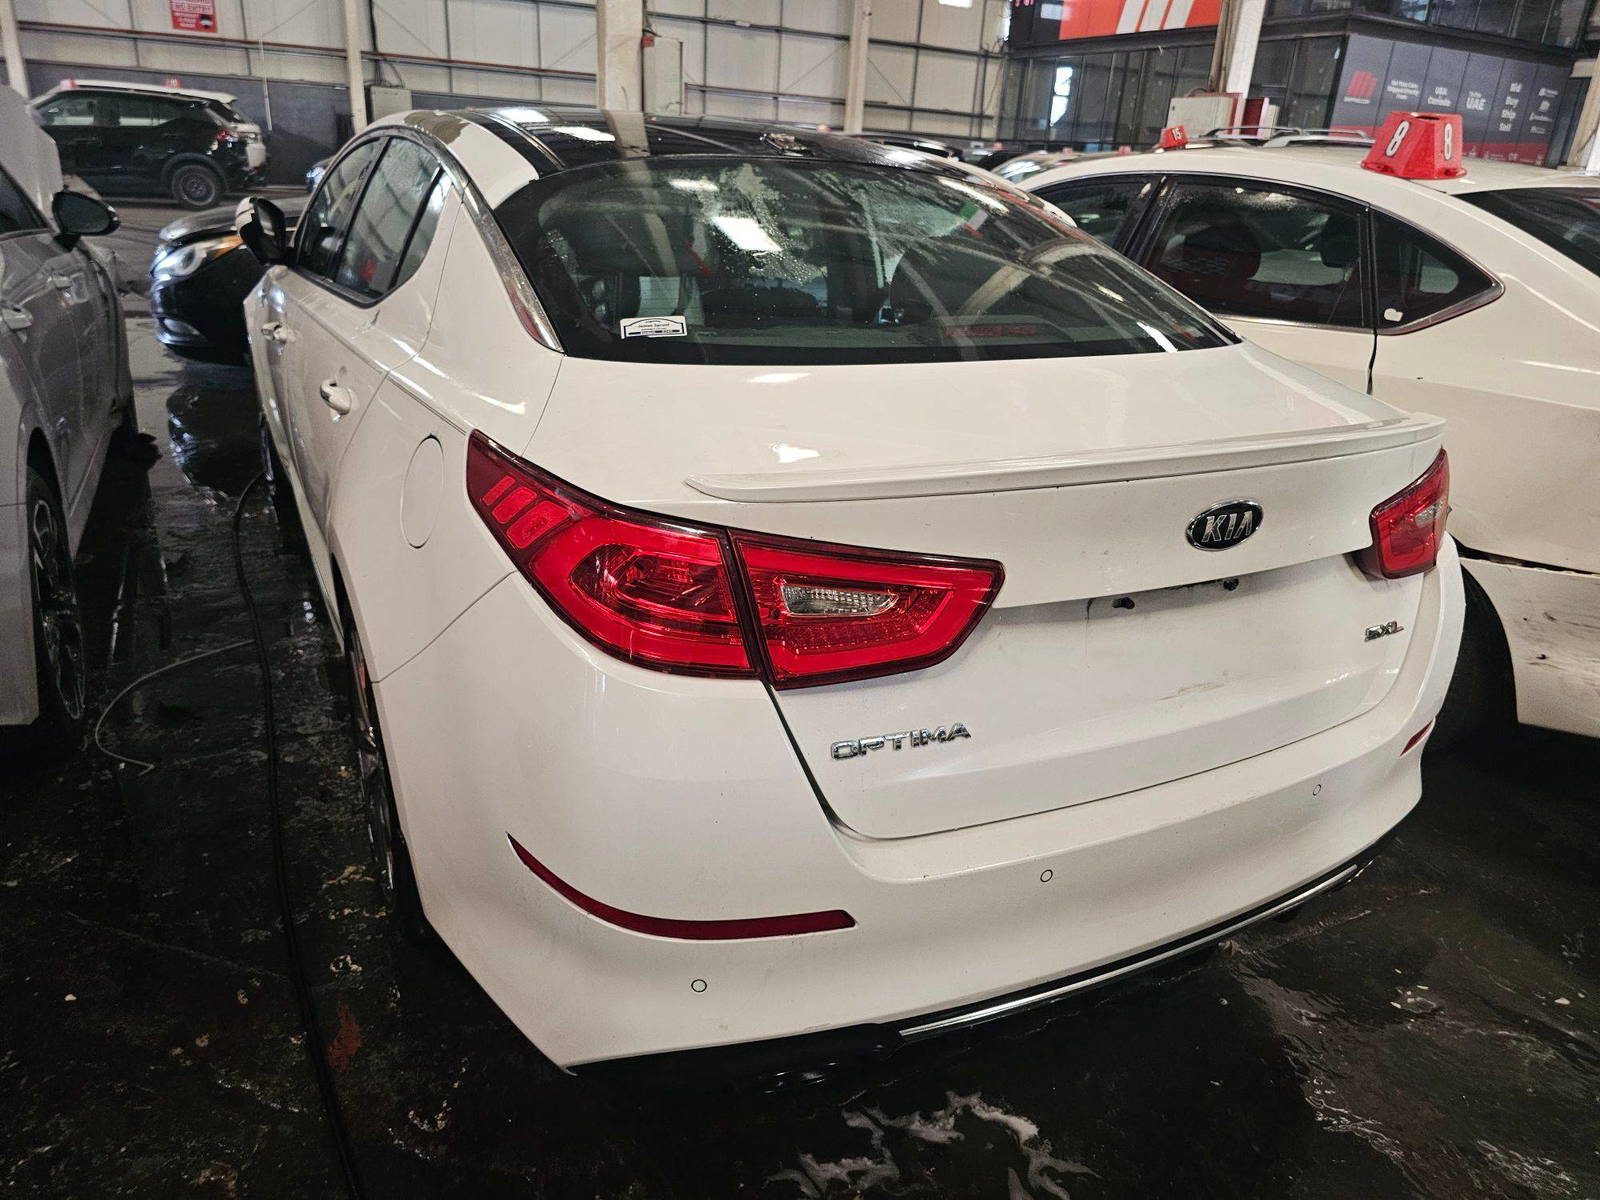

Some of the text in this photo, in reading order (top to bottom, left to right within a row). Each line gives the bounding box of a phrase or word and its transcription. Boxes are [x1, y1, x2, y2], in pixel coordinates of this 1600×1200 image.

[1466, 98, 1486, 111] UAE
[1385, 120, 1410, 157] 8
[1444, 123, 1453, 160] 8
[1201, 511, 1252, 543] KIA
[831, 722, 971, 759] OPTIMA
